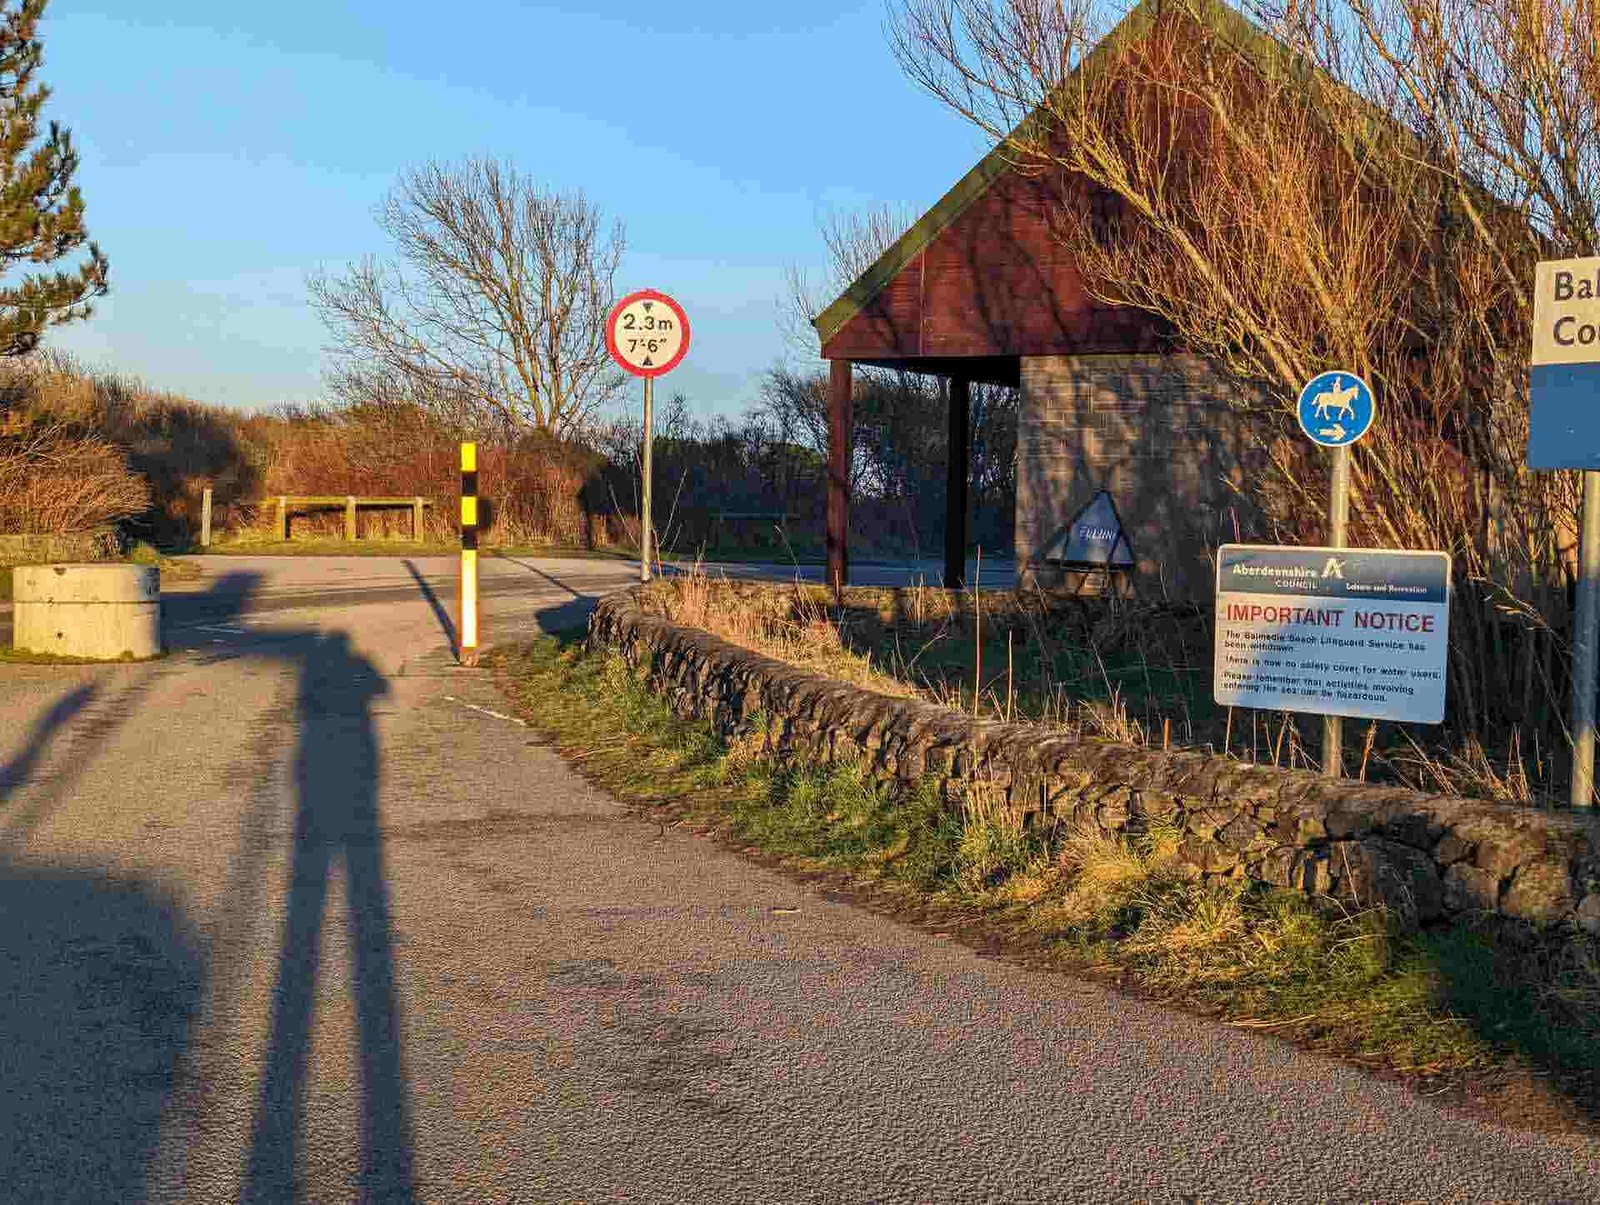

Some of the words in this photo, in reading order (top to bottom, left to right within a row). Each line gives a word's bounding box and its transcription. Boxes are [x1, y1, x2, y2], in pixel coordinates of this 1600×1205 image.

[1553, 316, 1600, 346] Co
[1275, 579, 1318, 589] COUNCIL
[1227, 604, 1344, 627] IMPORTANT
[1354, 610, 1434, 632] NOTICE
[1263, 659, 1282, 667] now
[1286, 660, 1297, 668] no
[1333, 664, 1359, 673] cover
[1363, 664, 1377, 674] for
[1381, 667, 1407, 676] water
